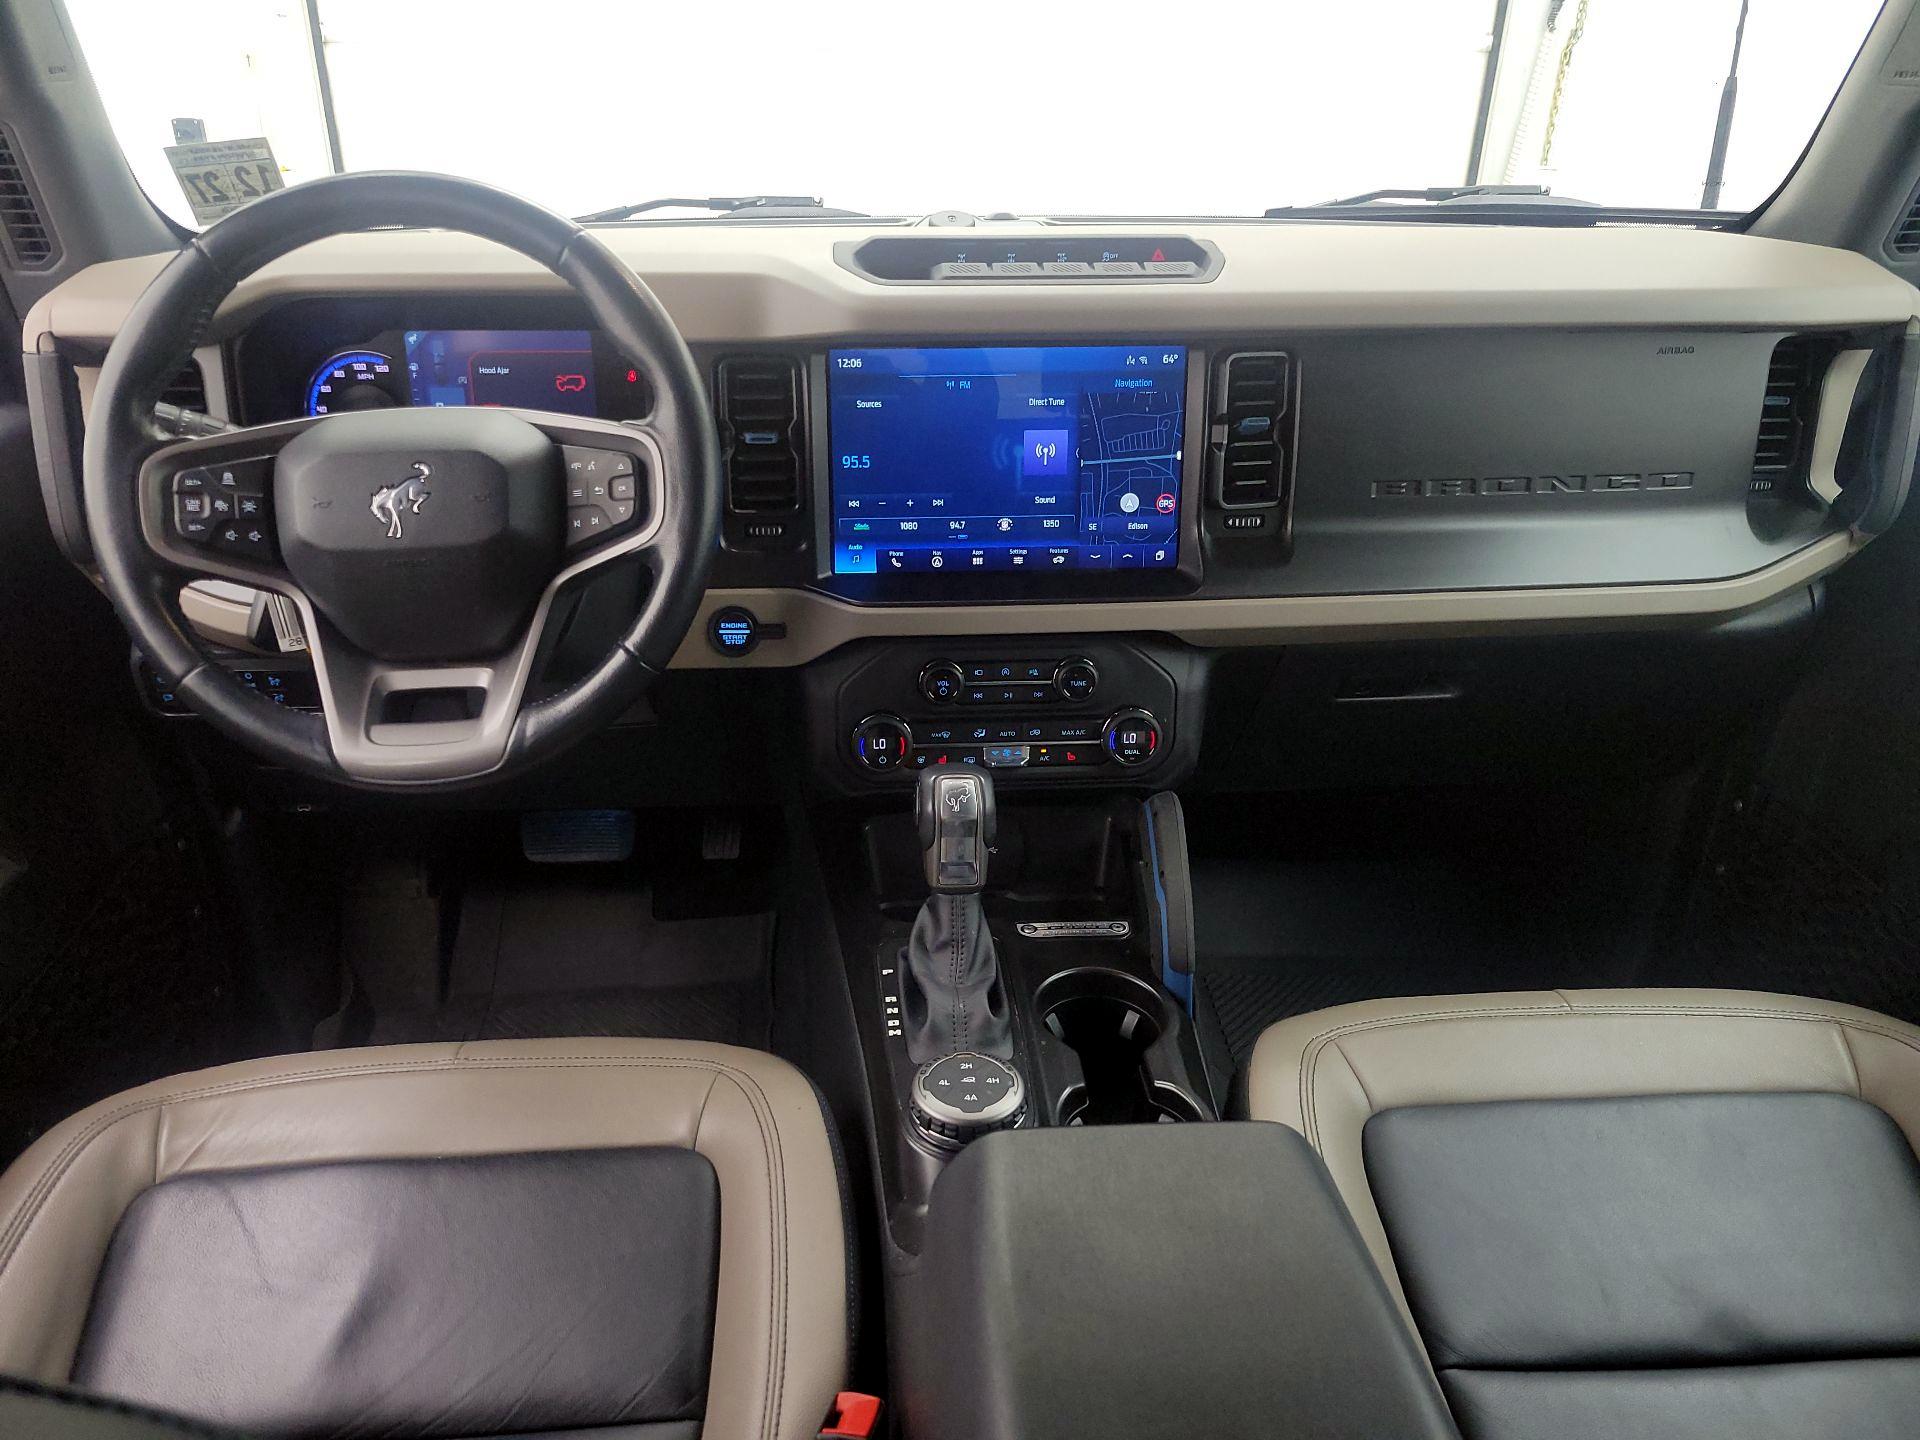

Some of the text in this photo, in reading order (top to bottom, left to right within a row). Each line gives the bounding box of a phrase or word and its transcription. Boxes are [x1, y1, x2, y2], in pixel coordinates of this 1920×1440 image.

[1656, 346, 1695, 355] AIRBAG
[837, 358, 862, 368] 12:06
[1162, 354, 1178, 364] 64°
[479, 366, 496, 374] Hood
[960, 380, 970, 389] FM
[1114, 379, 1152, 388] Navigation
[856, 400, 882, 408] Sources
[1029, 398, 1065, 406] Direct Tune
[842, 456, 870, 469] 95.5
[1370, 472, 1695, 498] BRONCO
[1034, 496, 1056, 504] Sound
[1158, 500, 1173, 508] GPS
[900, 522, 918, 530] 1080
[950, 521, 966, 530] 94.7
[1043, 520, 1060, 528] 1350
[1124, 733, 1136, 744] LO
[873, 738, 886, 750] LO
